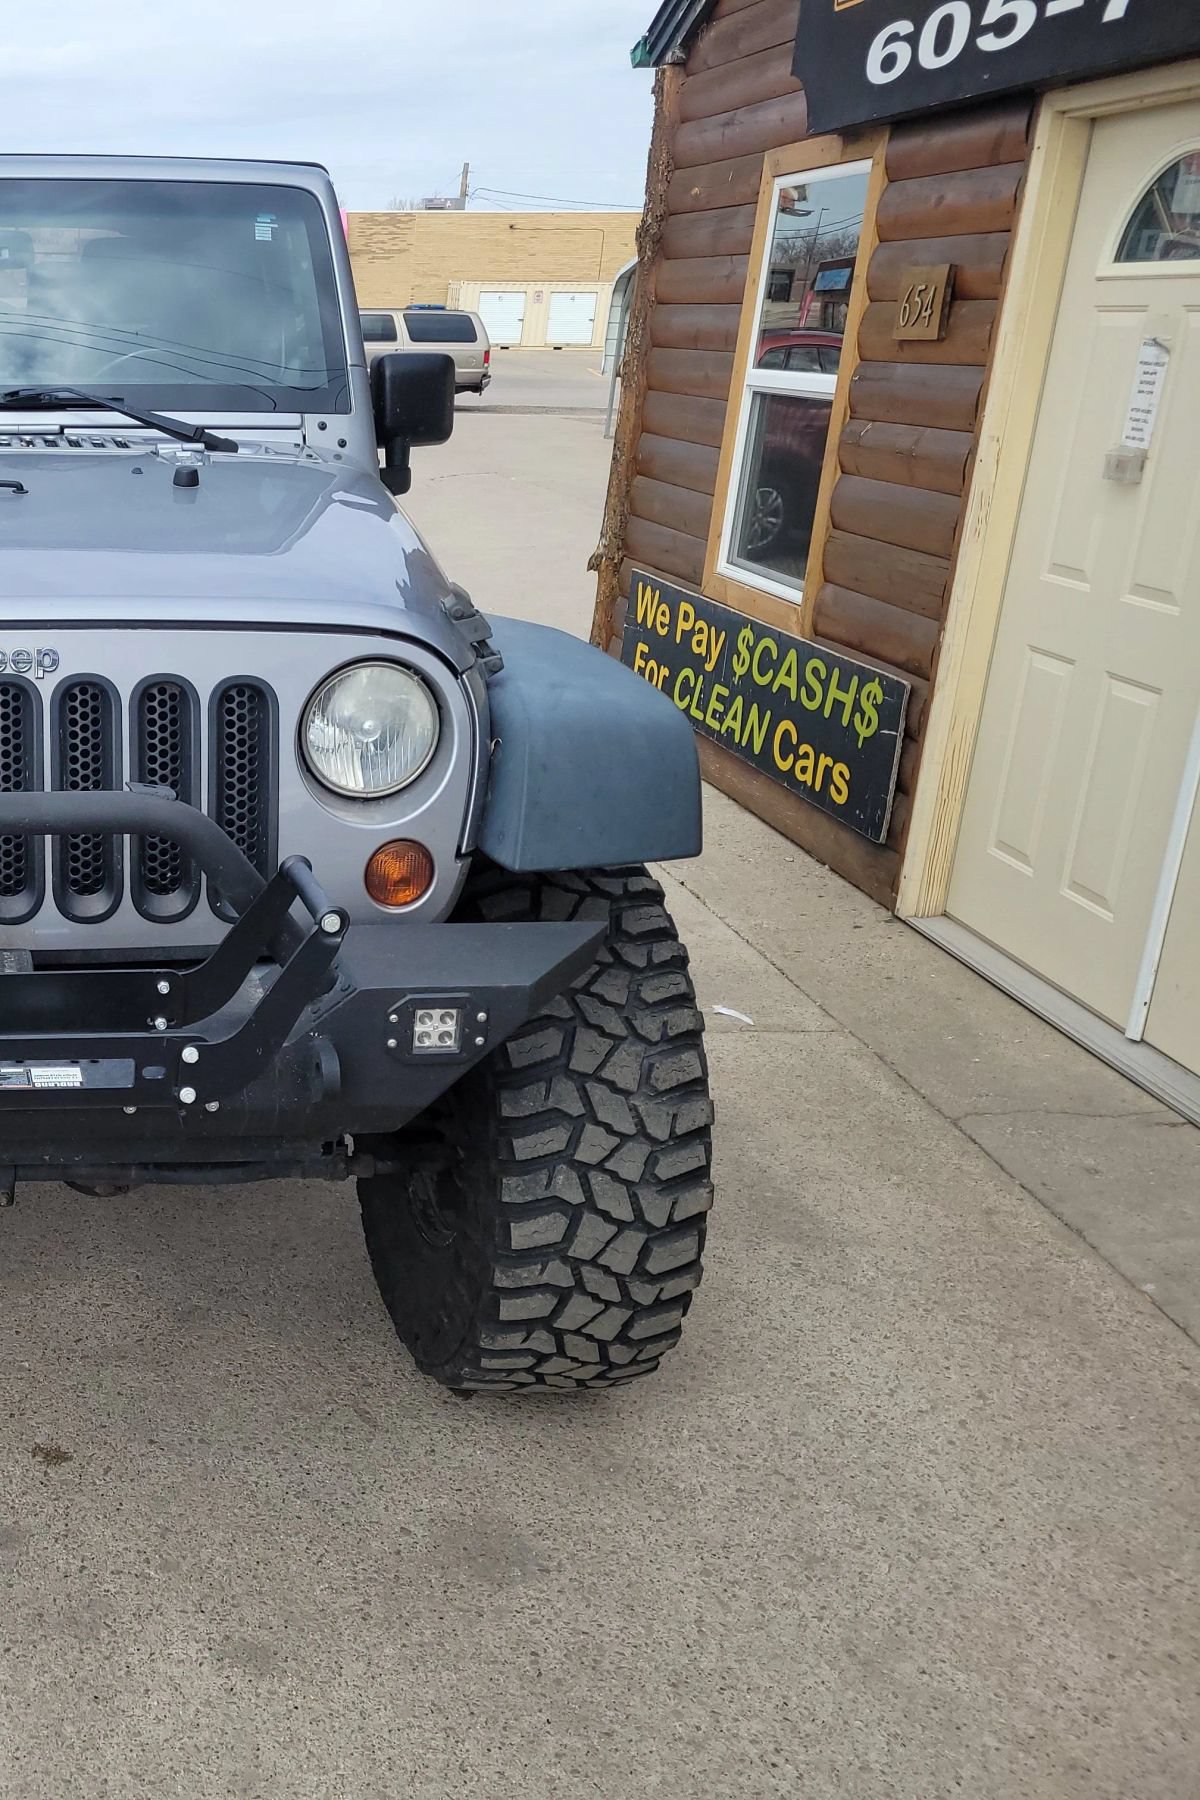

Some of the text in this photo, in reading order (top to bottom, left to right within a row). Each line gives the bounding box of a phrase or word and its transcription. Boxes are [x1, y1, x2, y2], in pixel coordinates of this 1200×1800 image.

[900, 285, 937, 327] 654
[636, 581, 884, 749] We Pay $CASH$
[673, 667, 772, 755] CLEAN
[773, 719, 851, 805] Cars
